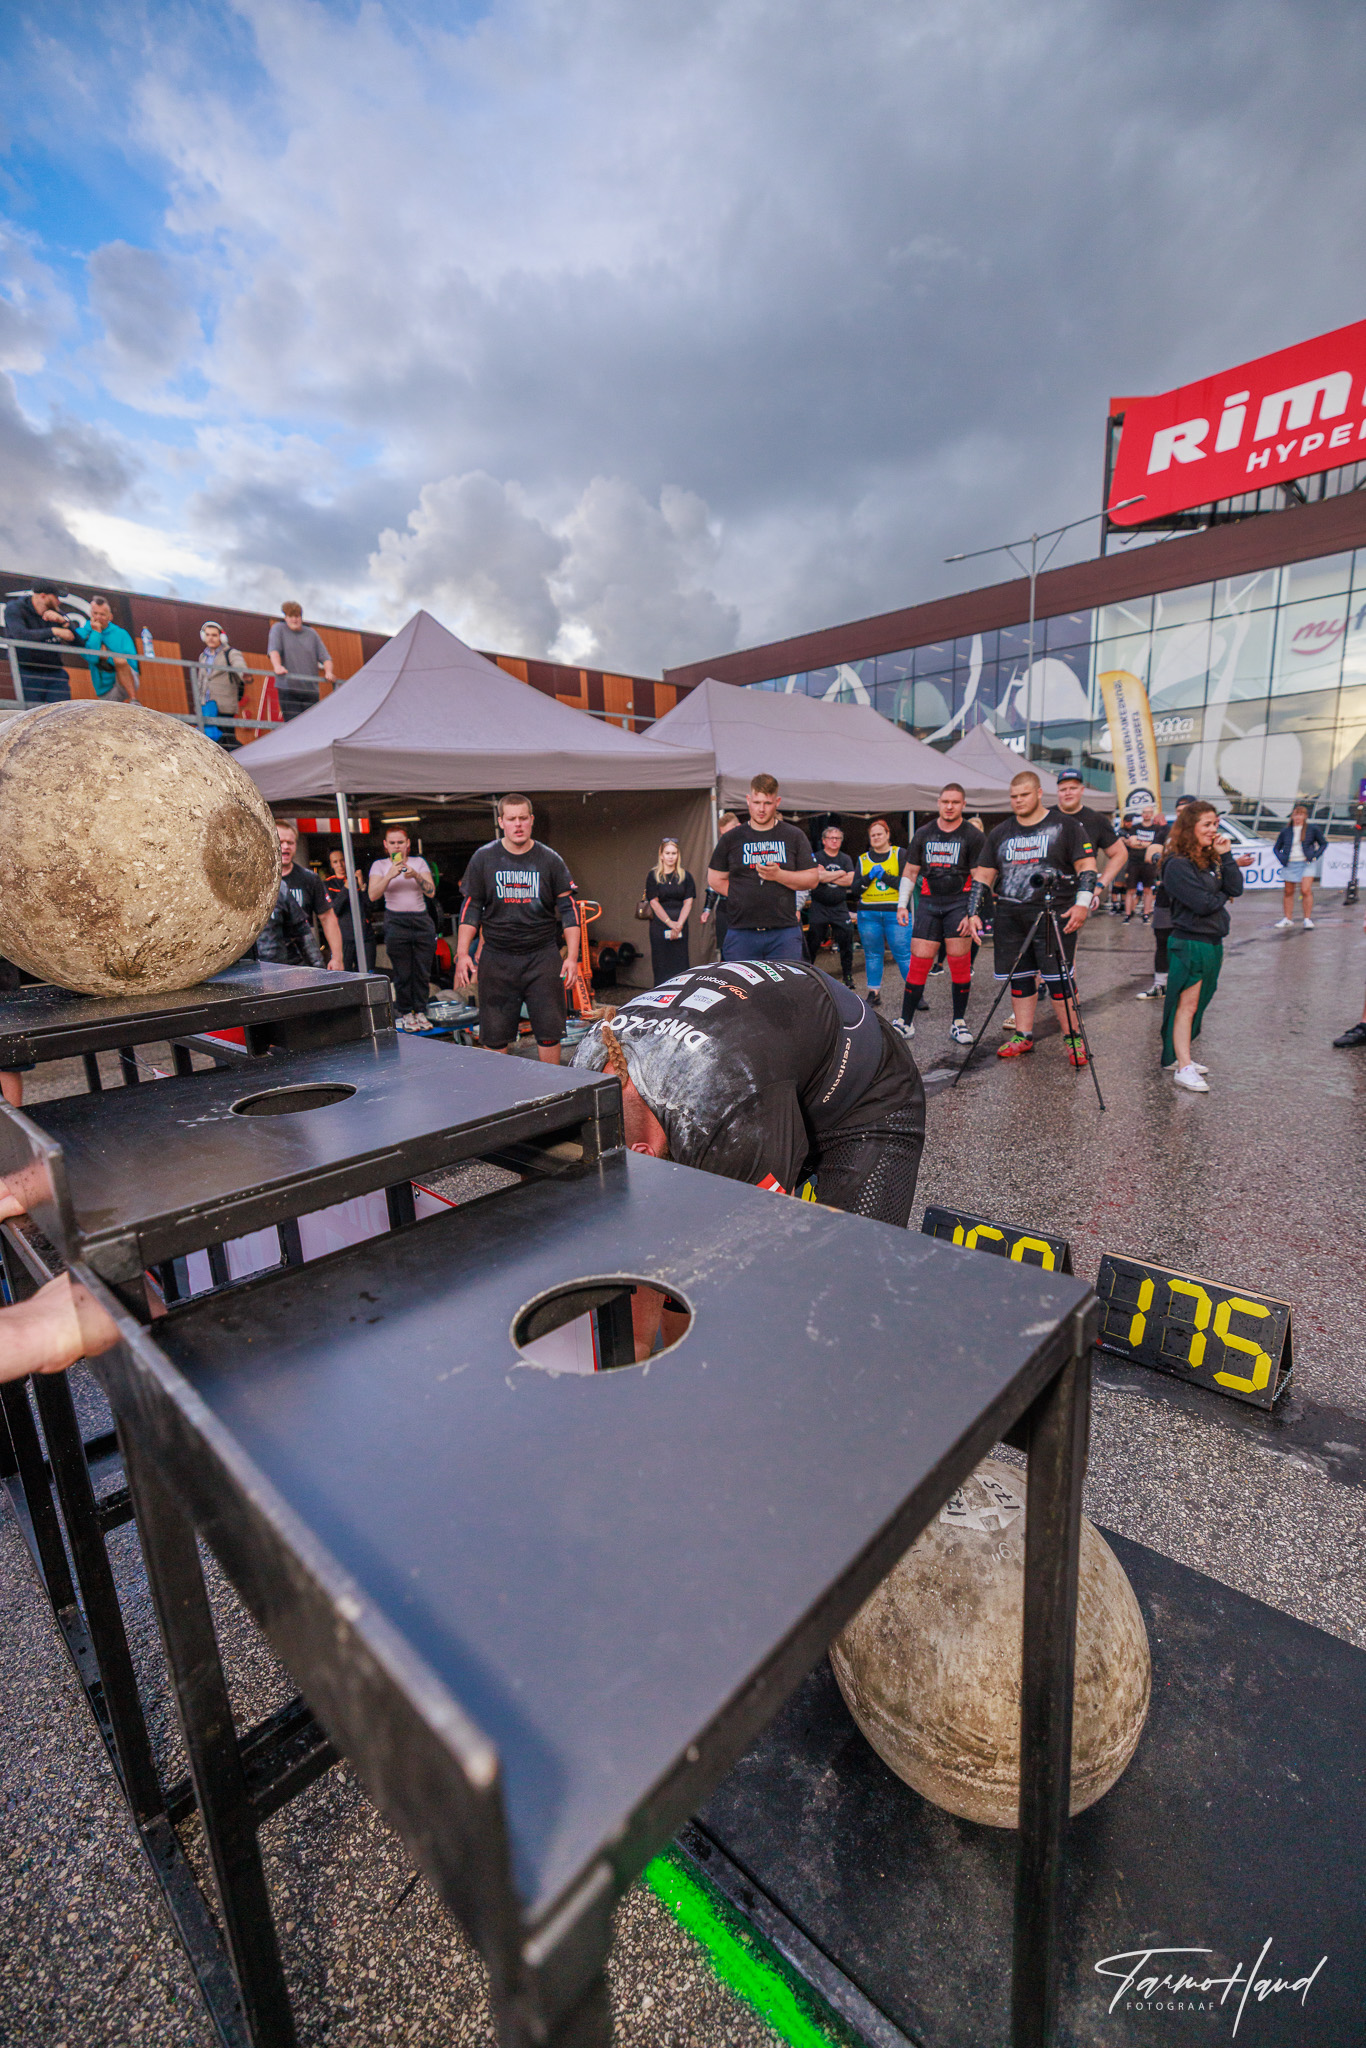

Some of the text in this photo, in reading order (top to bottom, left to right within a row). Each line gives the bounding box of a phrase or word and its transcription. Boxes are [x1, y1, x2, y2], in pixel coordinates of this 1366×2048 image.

[1147, 371, 1366, 475] Rim
[1128, 1277, 1273, 1394] 175
[983, 1480, 1020, 1510] 175
